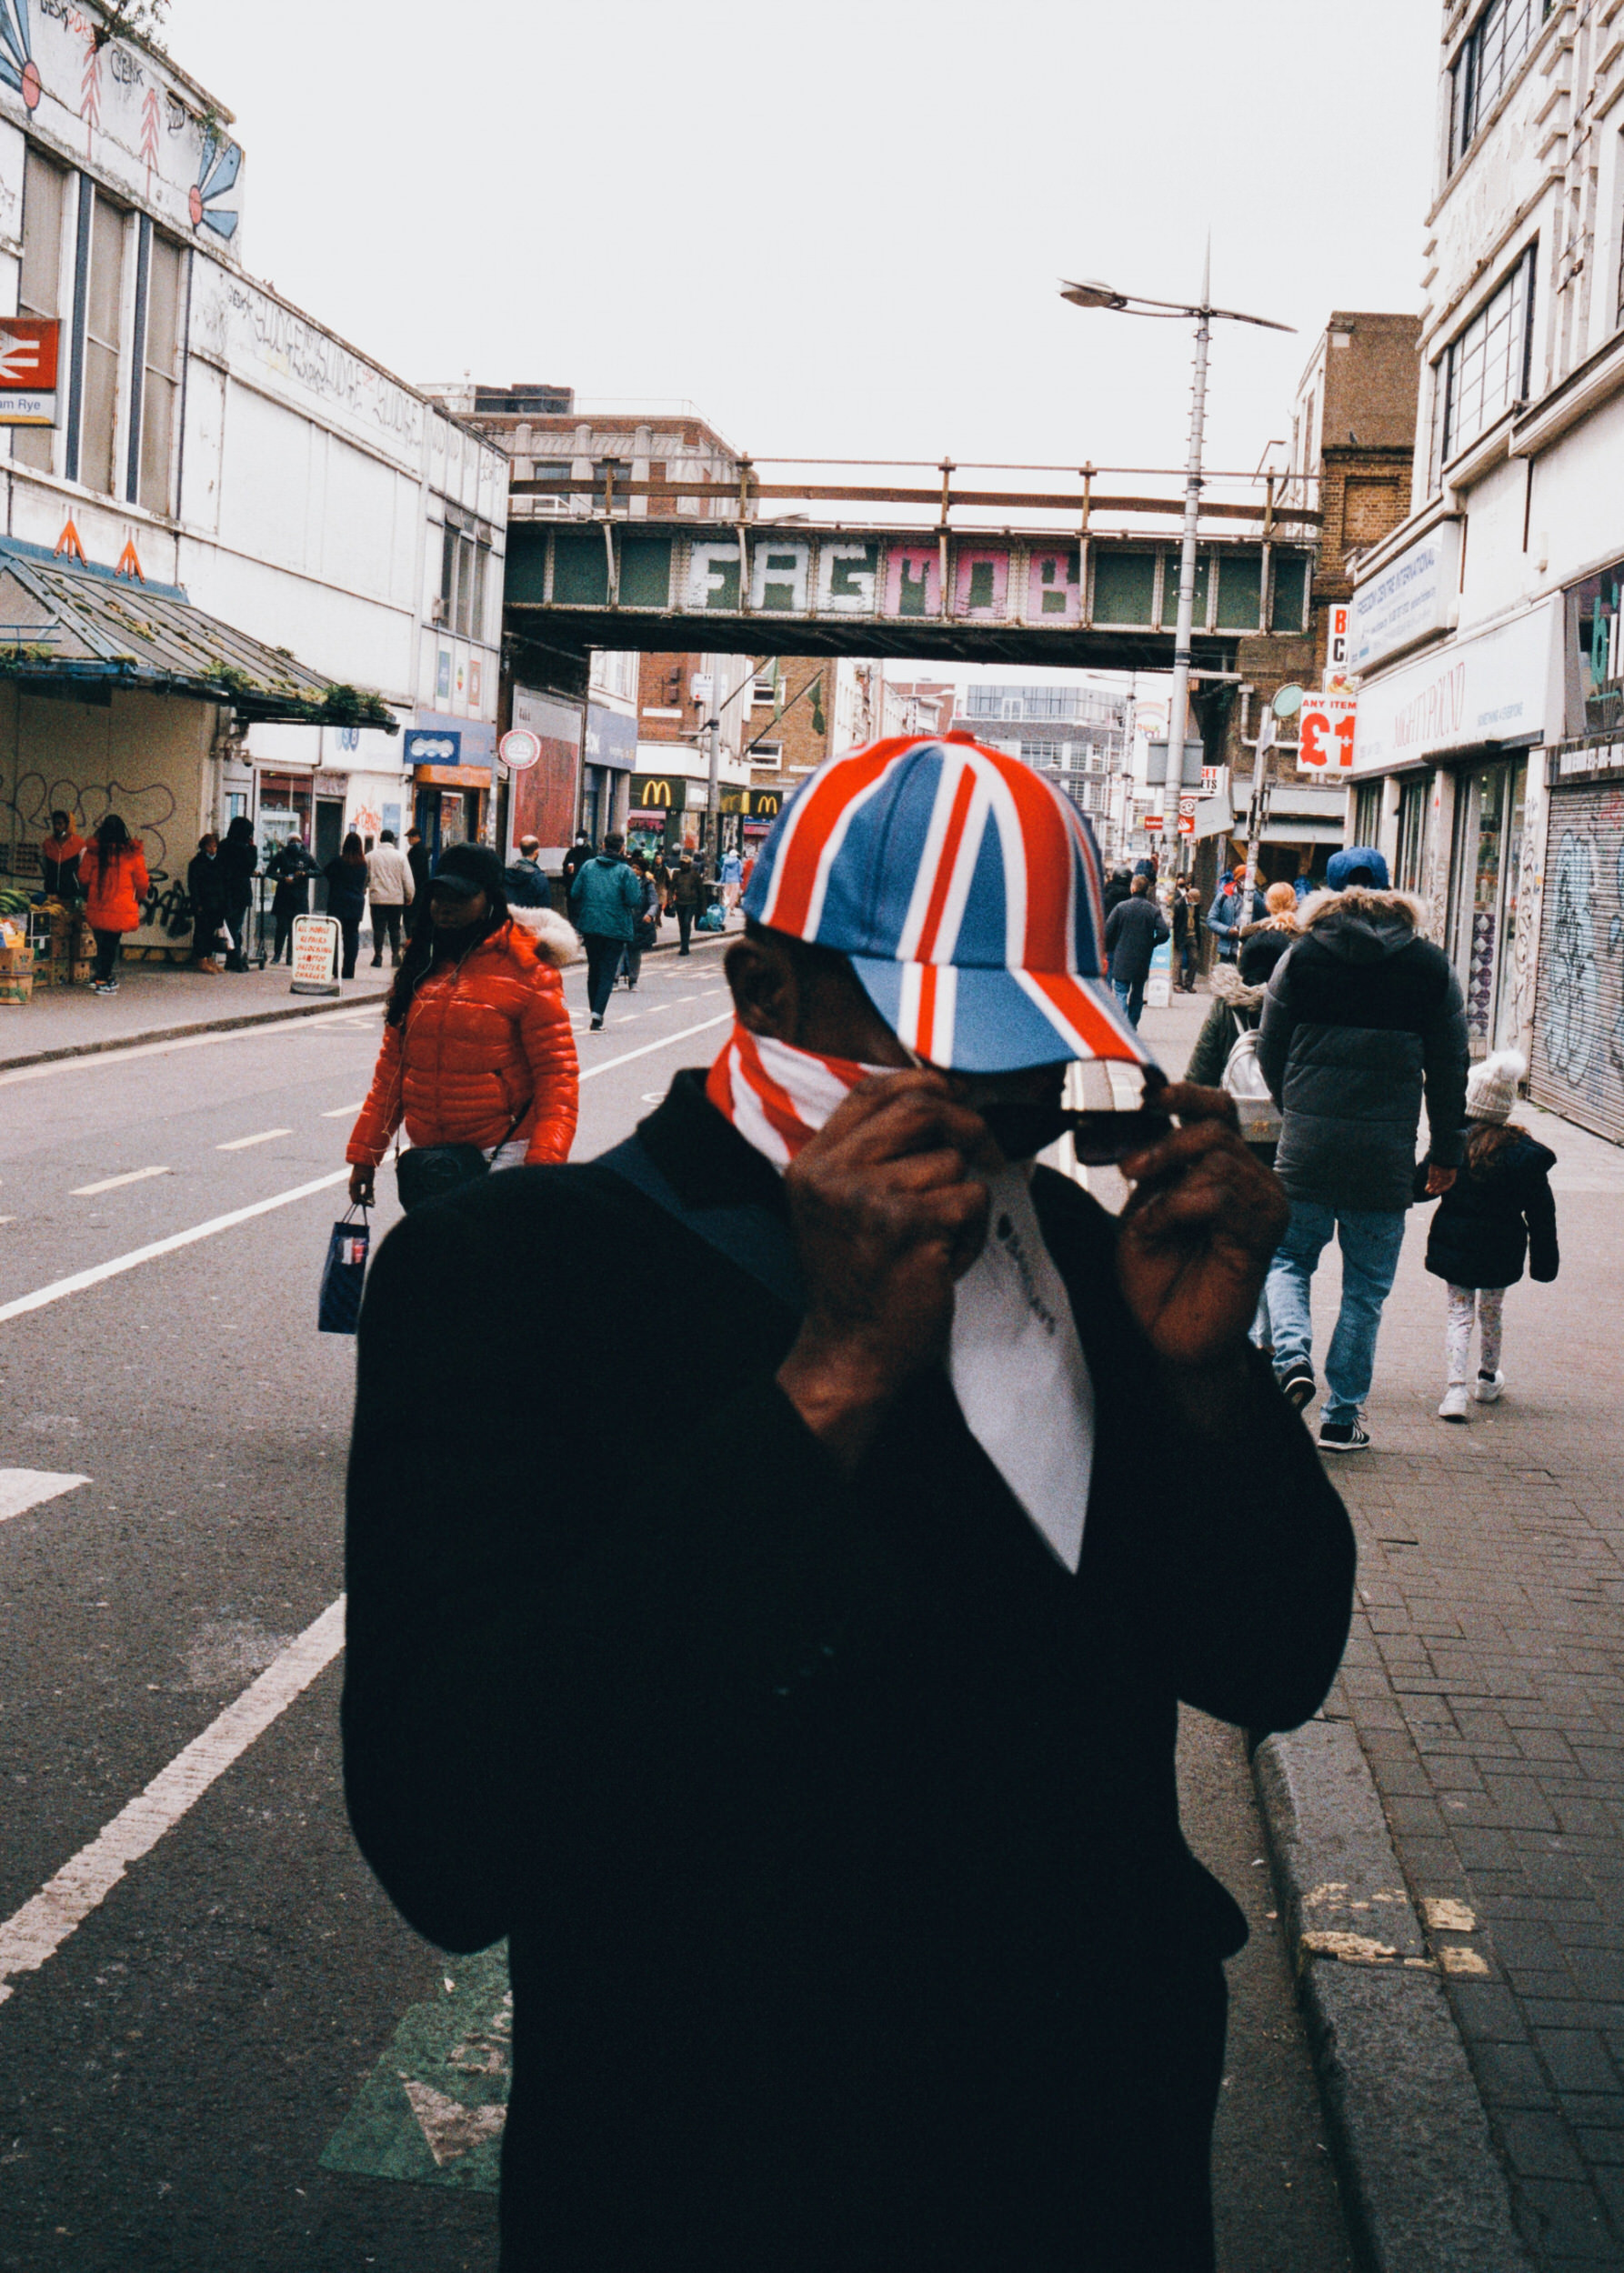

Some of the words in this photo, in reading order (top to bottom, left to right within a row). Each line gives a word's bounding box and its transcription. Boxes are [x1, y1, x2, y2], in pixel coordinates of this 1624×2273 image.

[18, 398, 41, 413] Rye
[1302, 699, 1326, 708] ANY
[1330, 699, 1358, 710] ITEM
